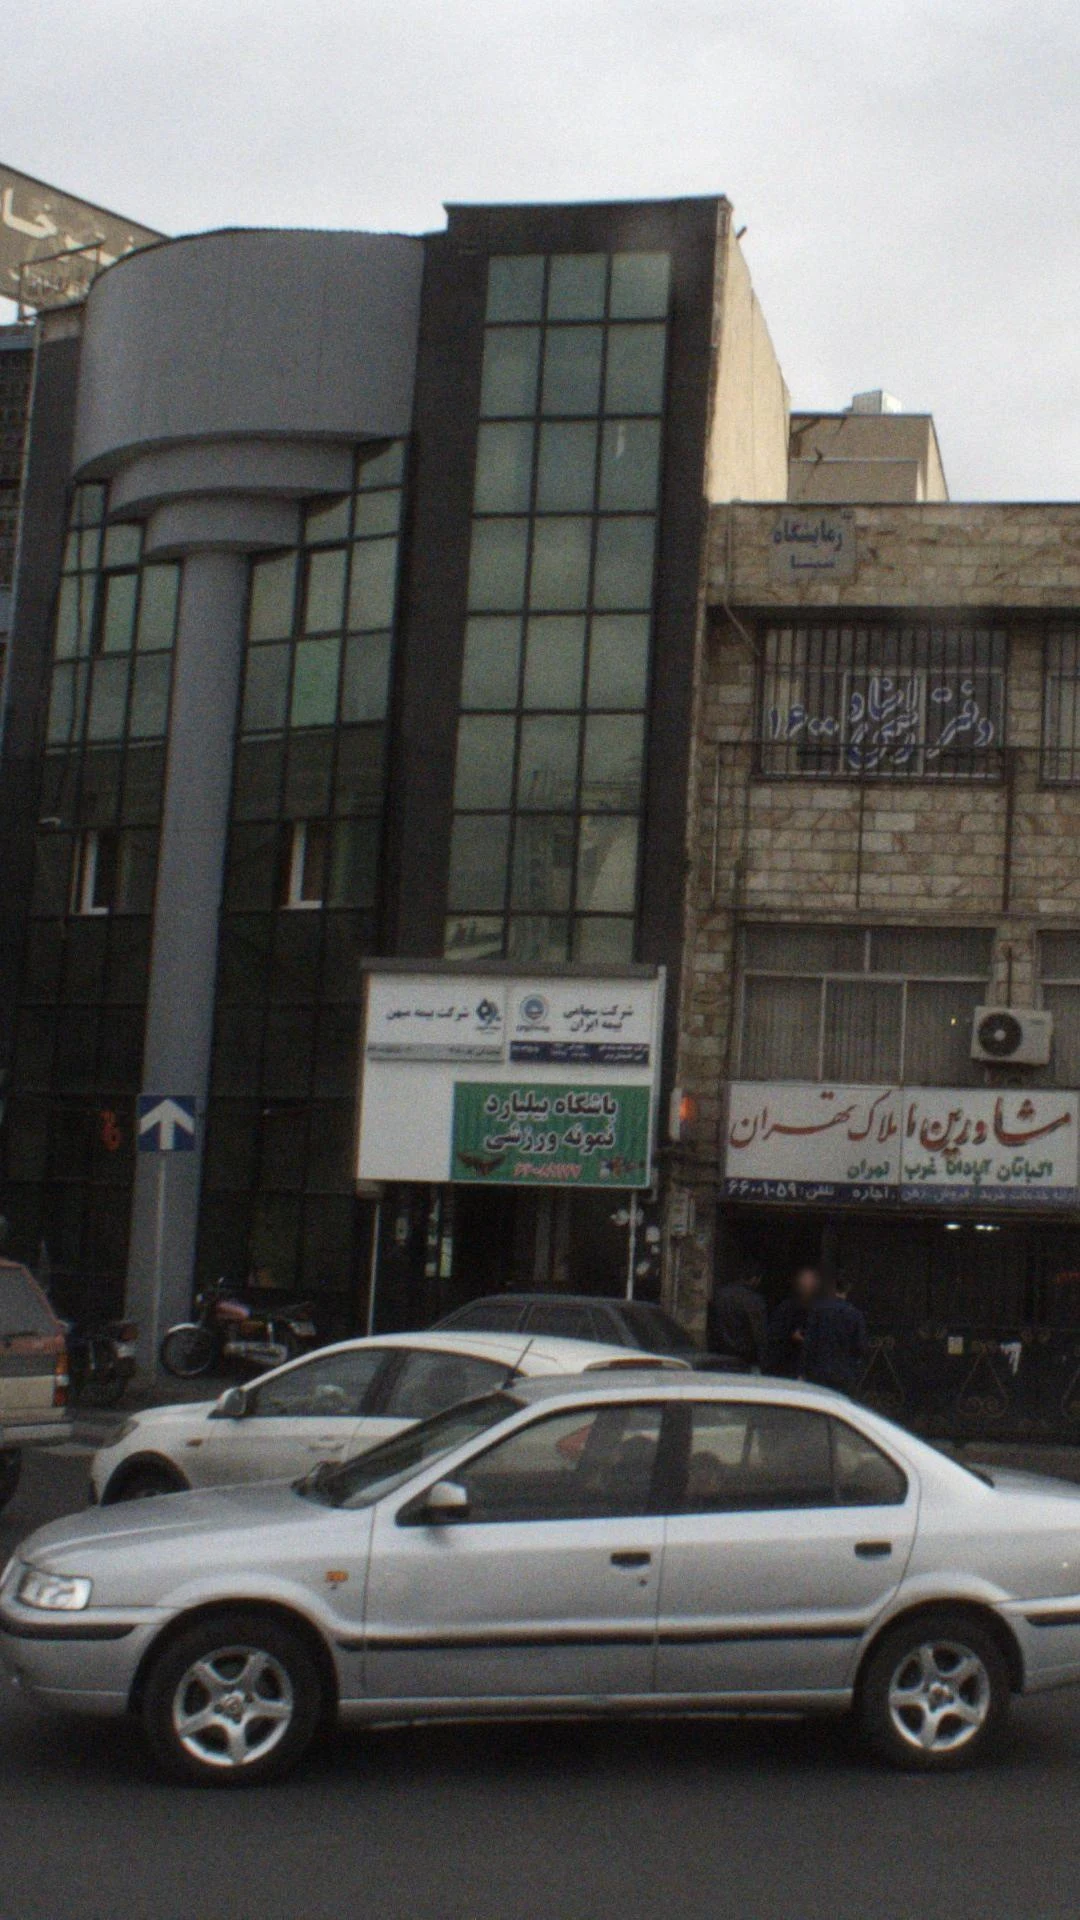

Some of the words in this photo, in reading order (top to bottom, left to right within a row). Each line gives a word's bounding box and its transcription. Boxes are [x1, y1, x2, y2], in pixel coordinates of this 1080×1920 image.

[926, 679, 994, 760] دفتر
[570, 1018, 598, 1033] ایران
[601, 1004, 634, 1020] شرکت
[484, 1090, 549, 1121] بیلیارد
[554, 1091, 617, 1119] باشگاه
[729, 1091, 857, 1149] تهران
[848, 1090, 917, 1143] املاک
[484, 1123, 561, 1154] ورزشی
[563, 1121, 615, 1155] نمونه
[919, 1096, 1072, 1158] مشاورین
[904, 1156, 937, 1180] غرب
